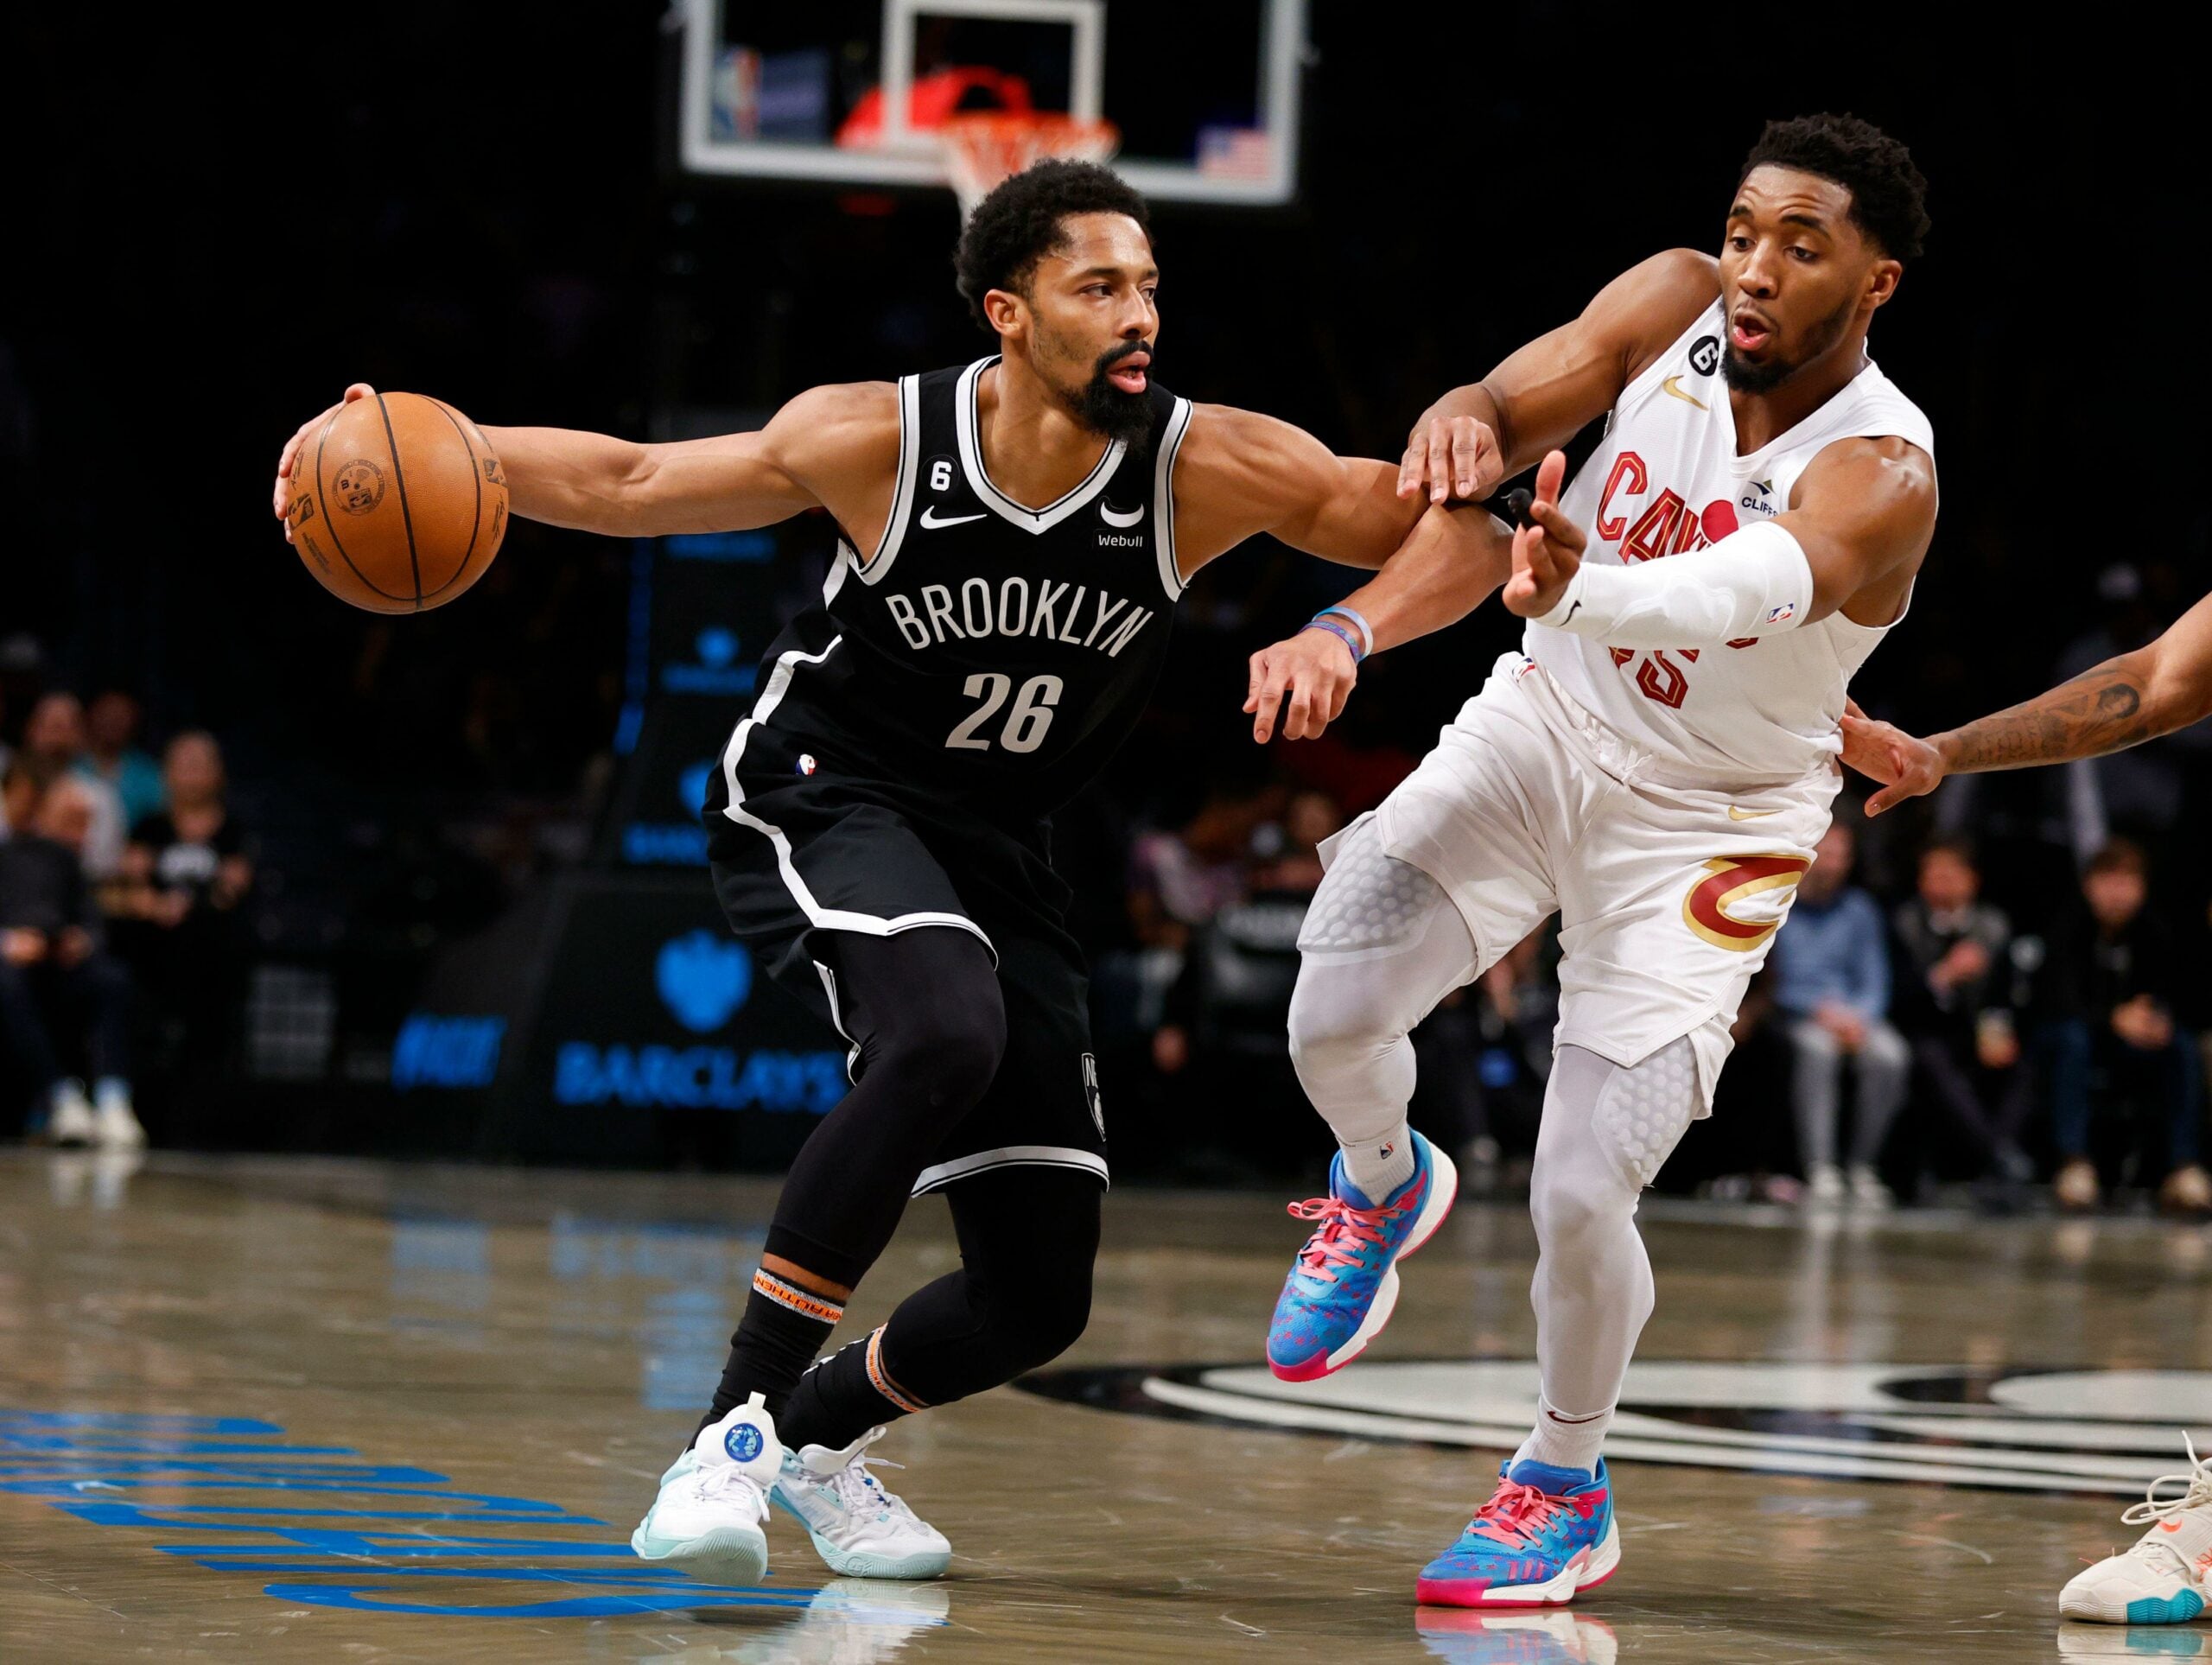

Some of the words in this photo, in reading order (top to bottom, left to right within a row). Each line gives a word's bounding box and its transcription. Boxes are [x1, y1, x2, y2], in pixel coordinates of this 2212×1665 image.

[1693, 341, 1719, 371] 6
[931, 461, 952, 492] 6
[1098, 534, 1143, 548] Webull
[886, 576, 1154, 658] BROOKLYN
[944, 672, 1064, 753] 26
